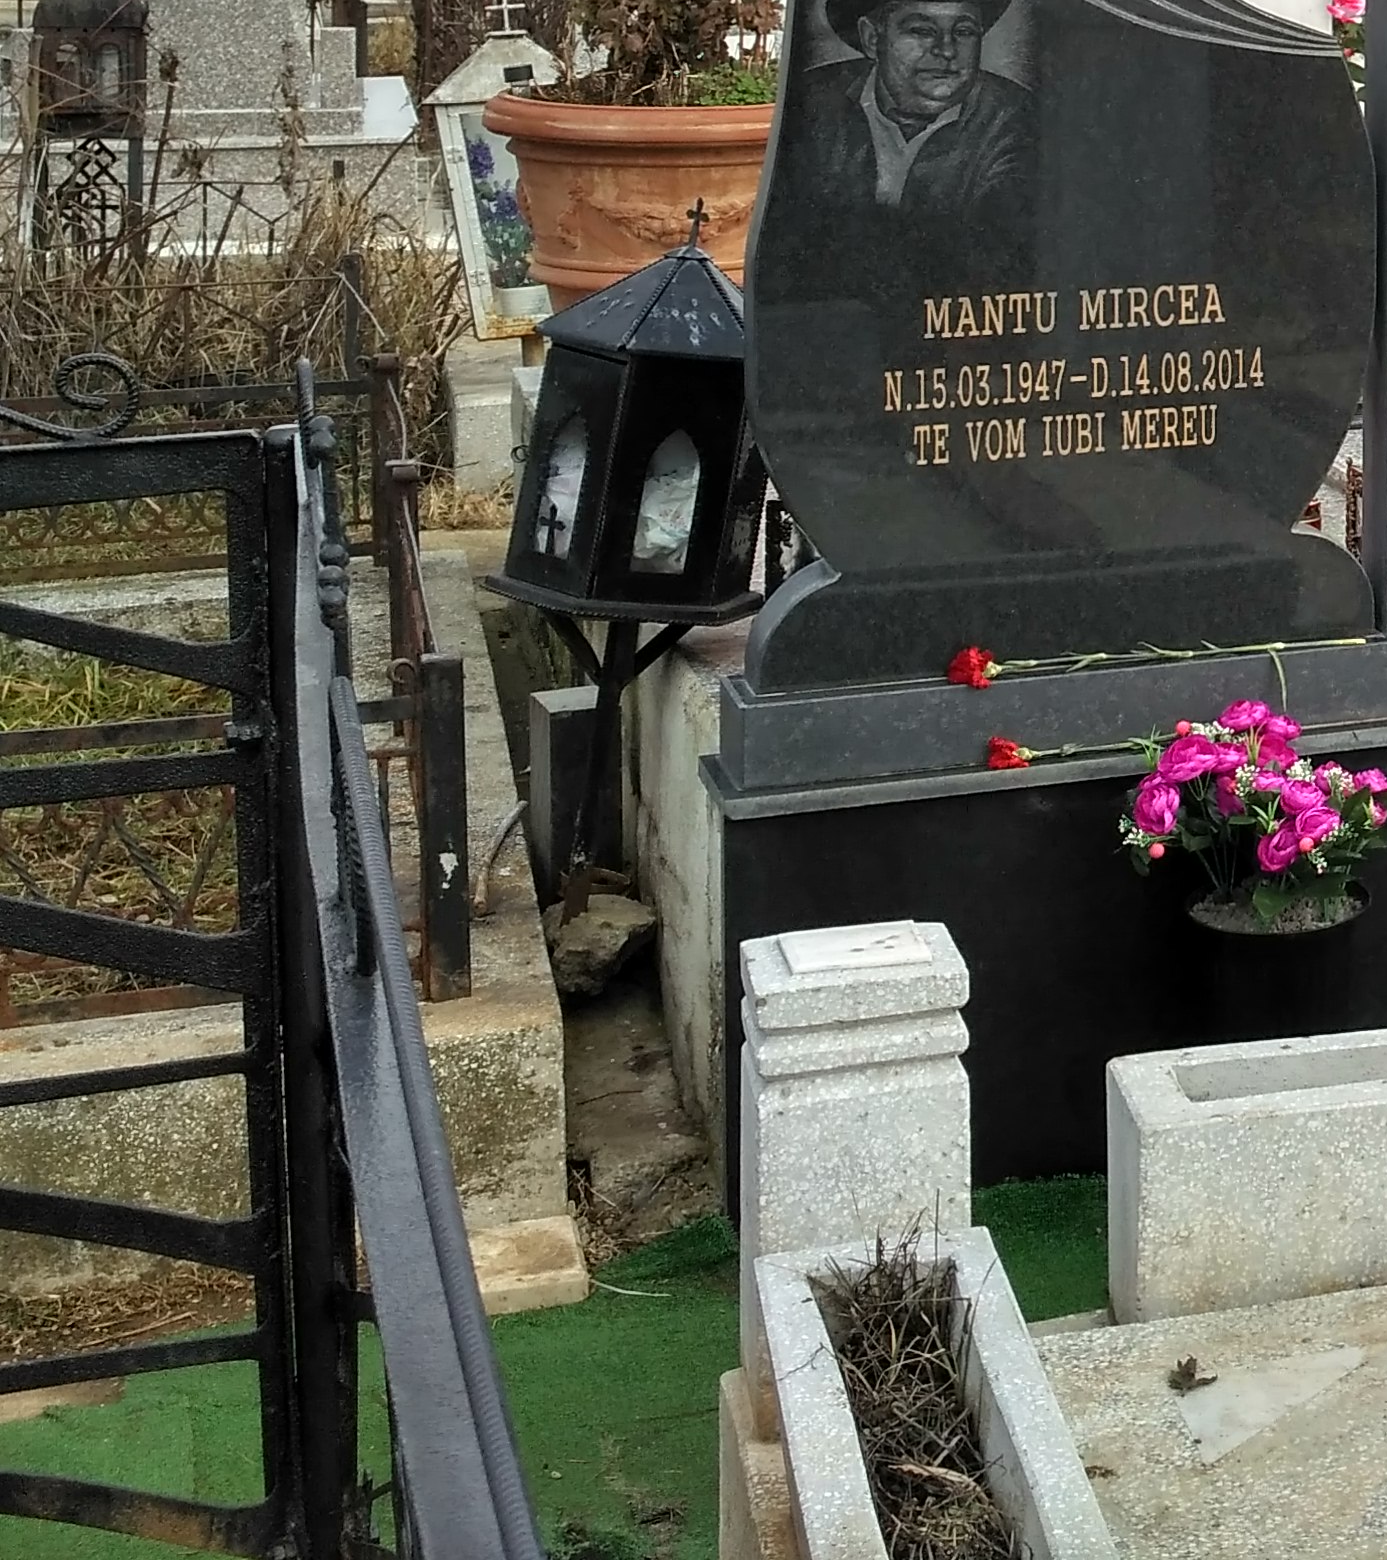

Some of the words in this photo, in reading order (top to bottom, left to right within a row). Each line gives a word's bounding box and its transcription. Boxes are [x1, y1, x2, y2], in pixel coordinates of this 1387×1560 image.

[923, 290, 1059, 339] MANTU
[1078, 283, 1226, 332] MIRCEA
[913, 423, 951, 466] TE
[966, 417, 1028, 463] VOM
[1042, 411, 1107, 457] IUBI
[1120, 403, 1219, 451] MEREU
